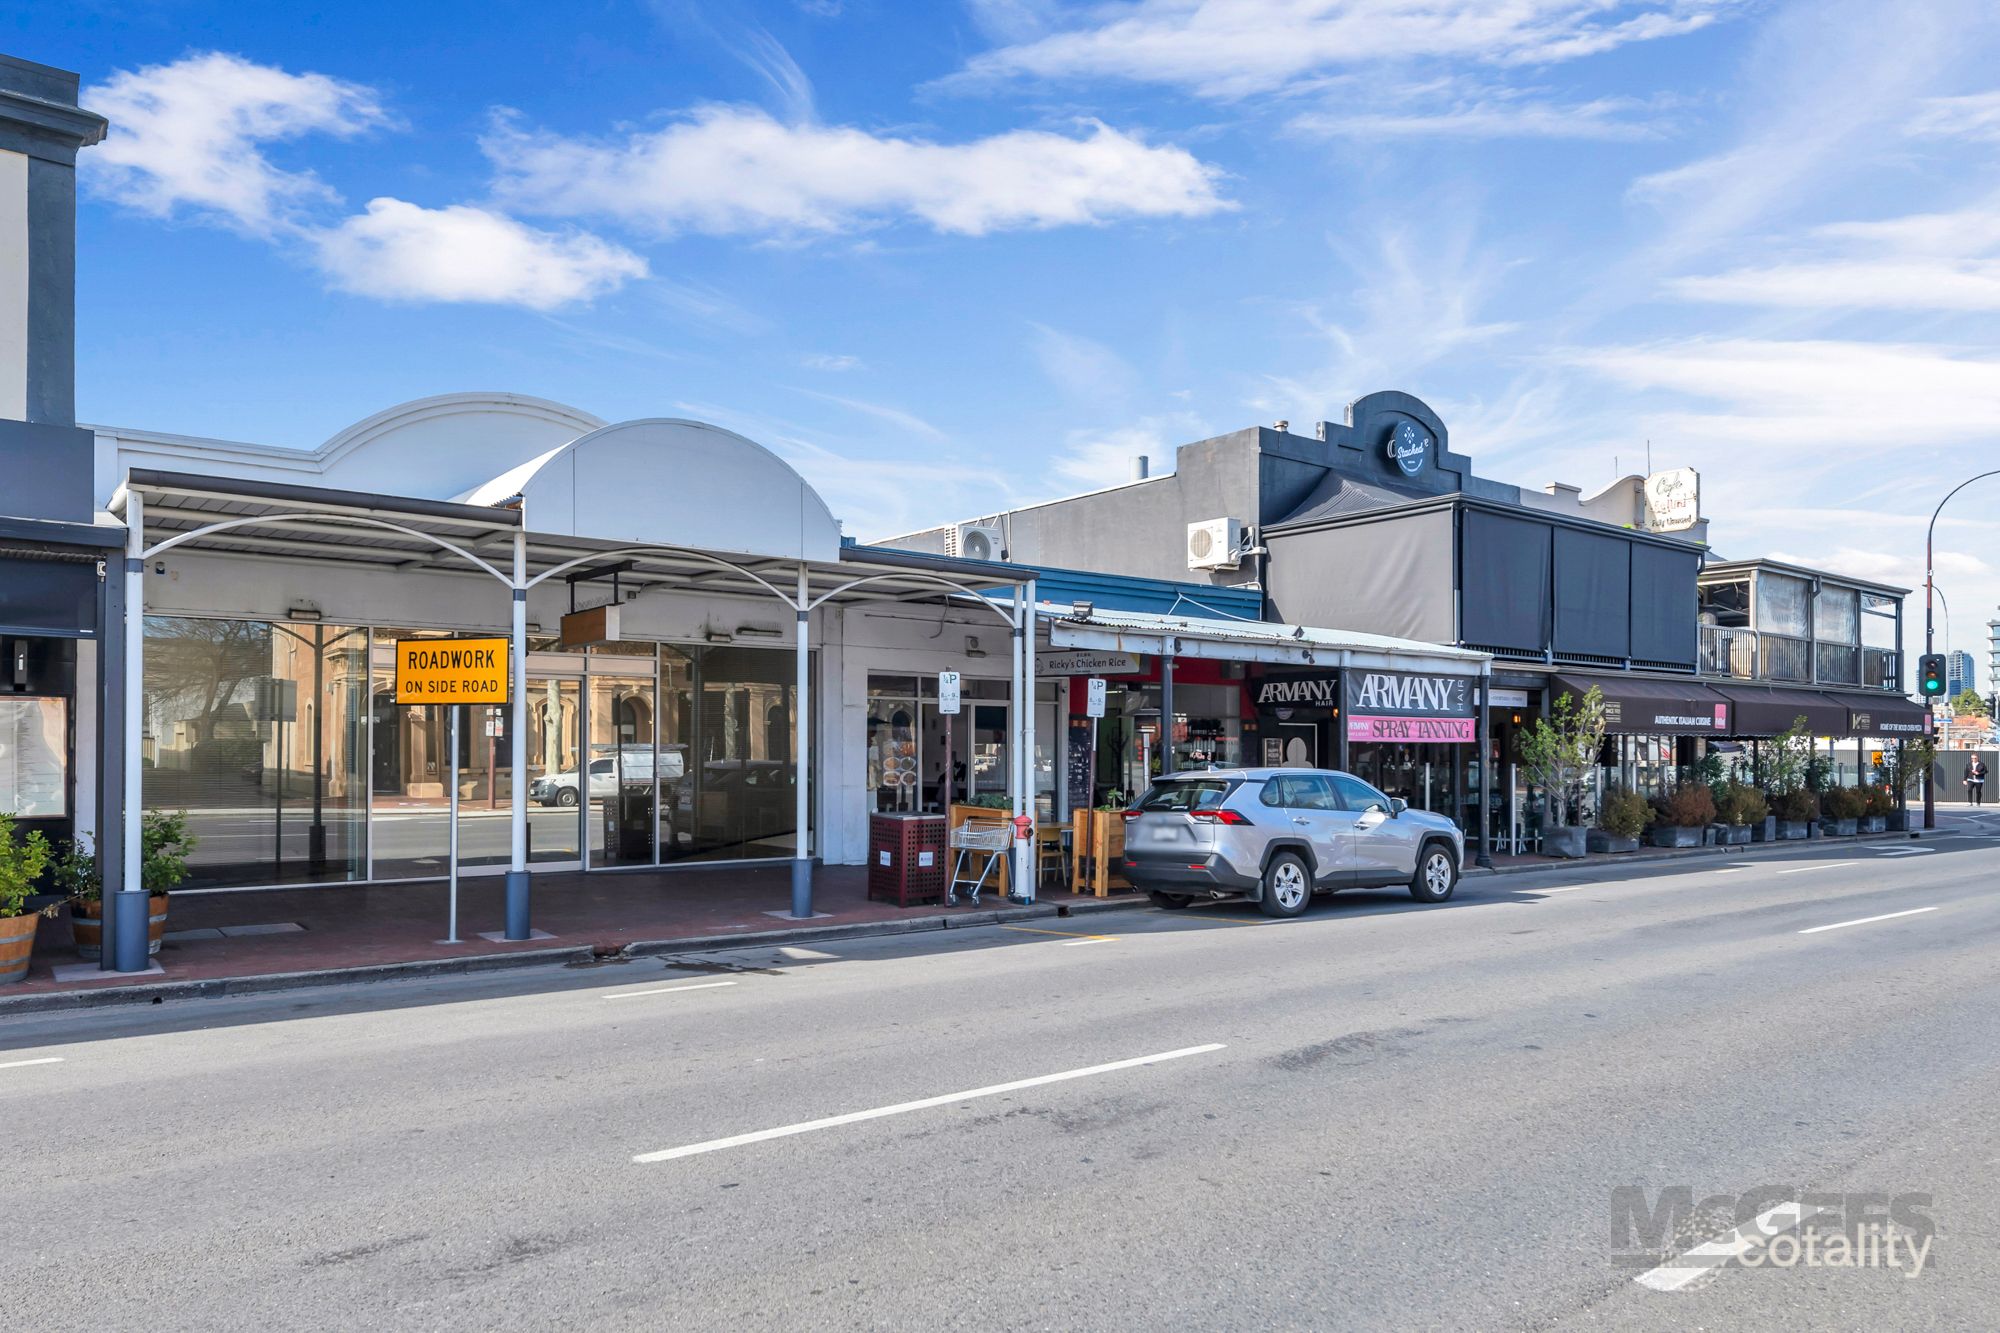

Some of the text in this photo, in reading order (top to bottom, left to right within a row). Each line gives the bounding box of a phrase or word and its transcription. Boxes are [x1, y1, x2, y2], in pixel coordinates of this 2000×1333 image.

[1398, 442, 1424, 458] Stacked
[408, 649, 495, 670] ROADWORK
[1049, 657, 1126, 671] Ricky's Chicken Rice
[405, 680, 498, 693] ON SIDE ROAD
[1257, 680, 1338, 703] ARMANY
[1355, 673, 1456, 711] ARMANY
[1372, 719, 1470, 739] SPRAY TANNING
[1655, 715, 1679, 725] AUTHENTIC
[1679, 716, 1696, 726] ITALIAN
[1696, 717, 1712, 726] CUISINE
